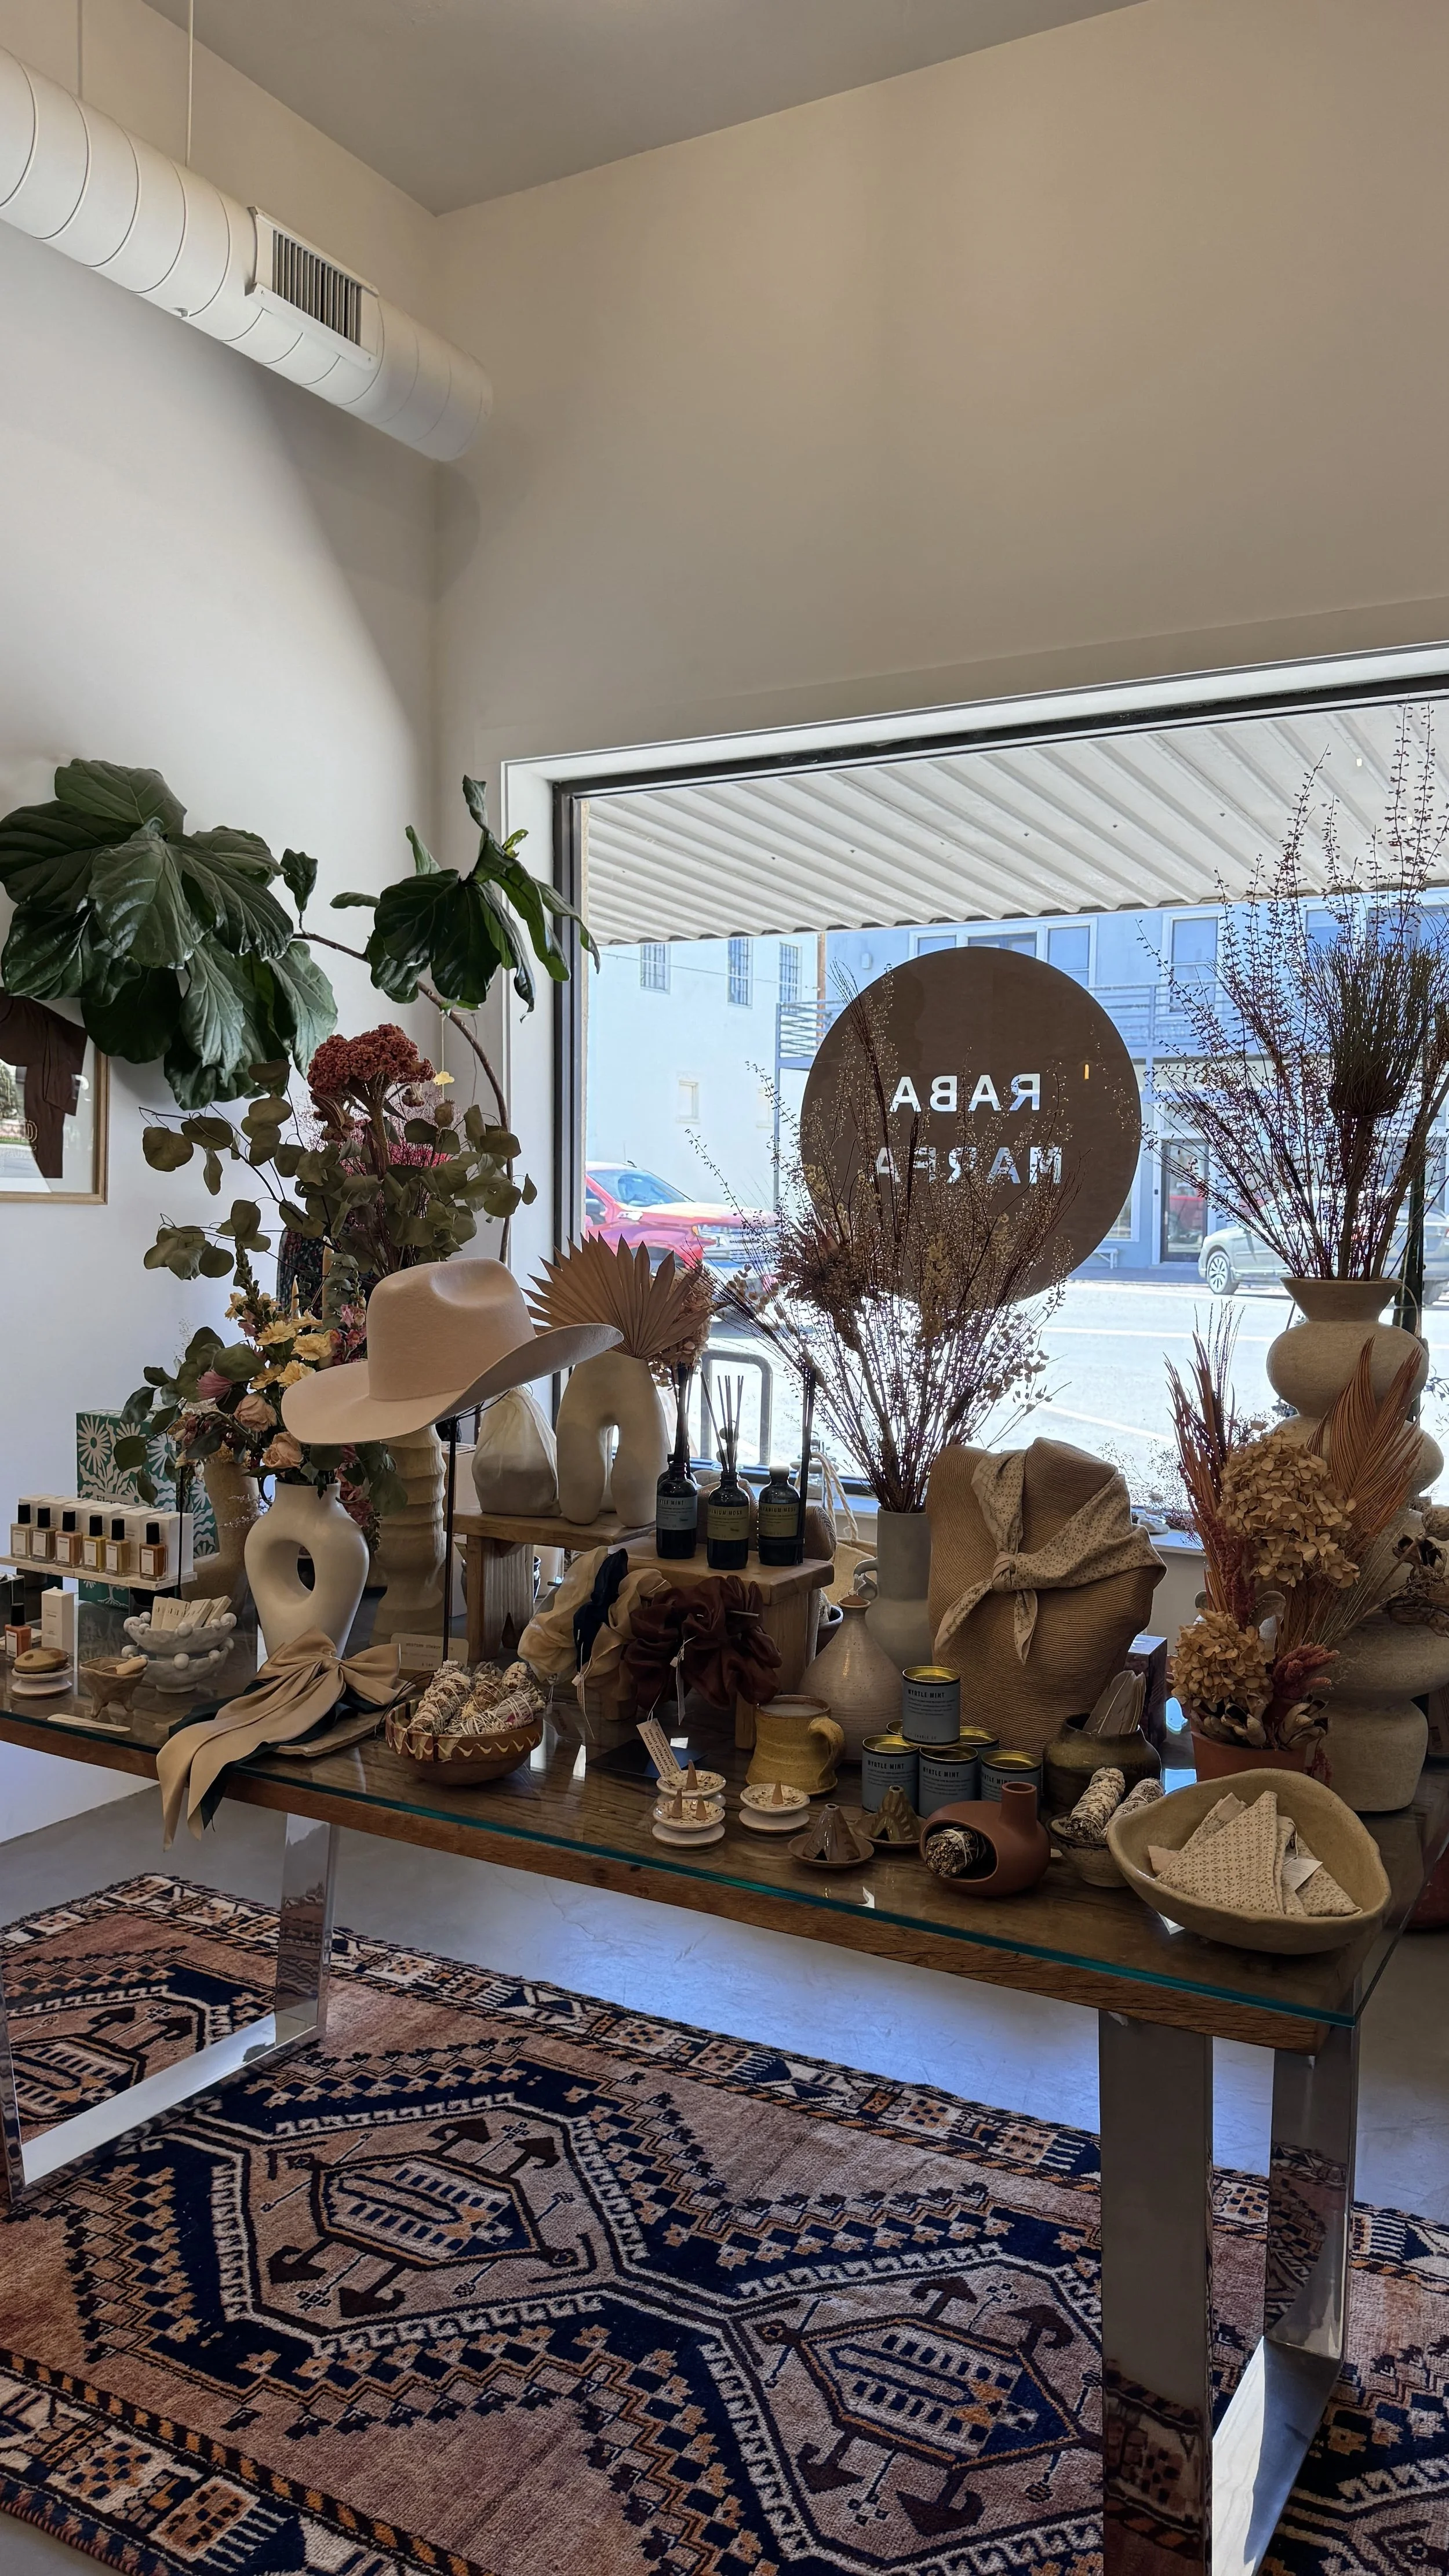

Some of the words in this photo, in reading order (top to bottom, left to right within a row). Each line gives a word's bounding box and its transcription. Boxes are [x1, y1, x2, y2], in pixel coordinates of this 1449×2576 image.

[908, 1689, 927, 1698] MYRTLE
[656, 1731, 664, 1747] WOOD
[651, 1747, 666, 1774] NATURALLY
[664, 1748, 675, 1766] ACACIA
[868, 1759, 887, 1769] MYRTLE
[923, 1767, 941, 1777] MYRTLE
